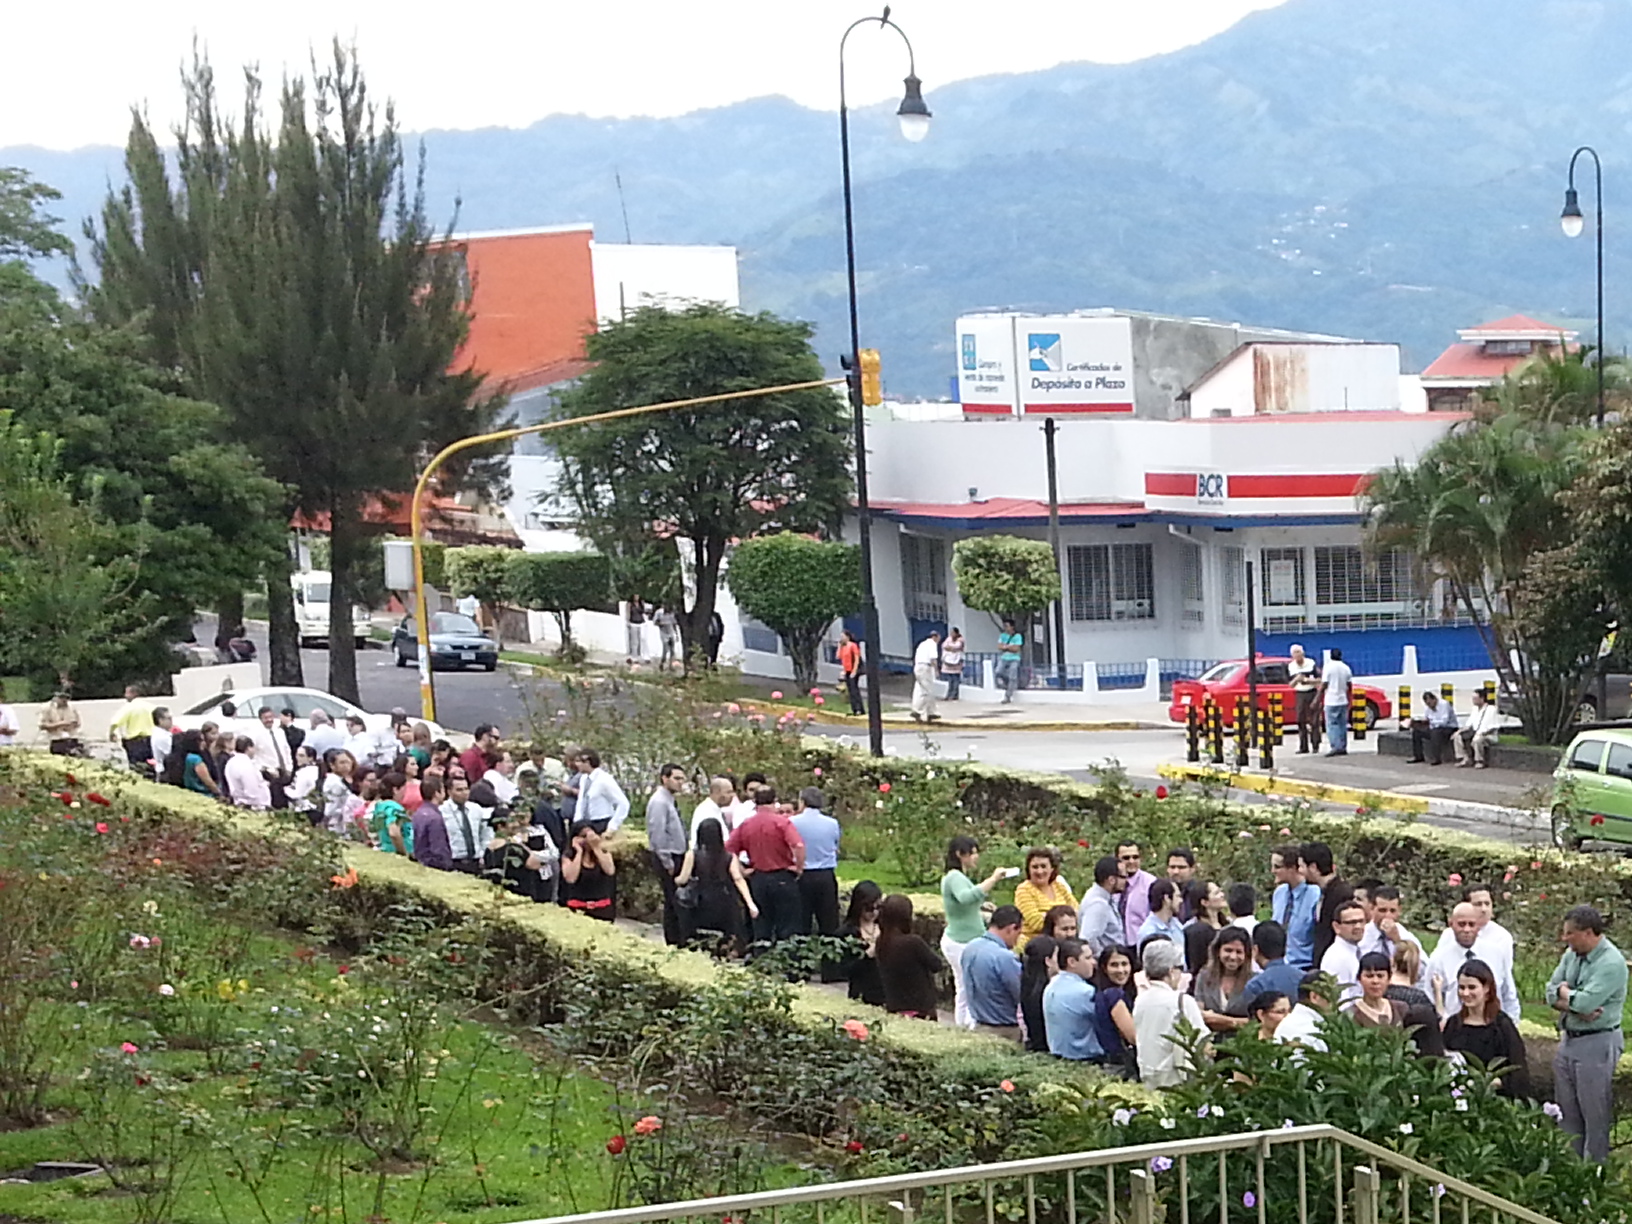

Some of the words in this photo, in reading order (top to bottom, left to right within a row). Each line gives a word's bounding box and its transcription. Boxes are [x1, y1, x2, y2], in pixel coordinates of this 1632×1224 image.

[1067, 362, 1110, 372] Certificados
[1112, 363, 1122, 372] de
[1084, 379, 1092, 389] a
[1095, 376, 1126, 389] Plazo
[1199, 473, 1223, 498] BCR
